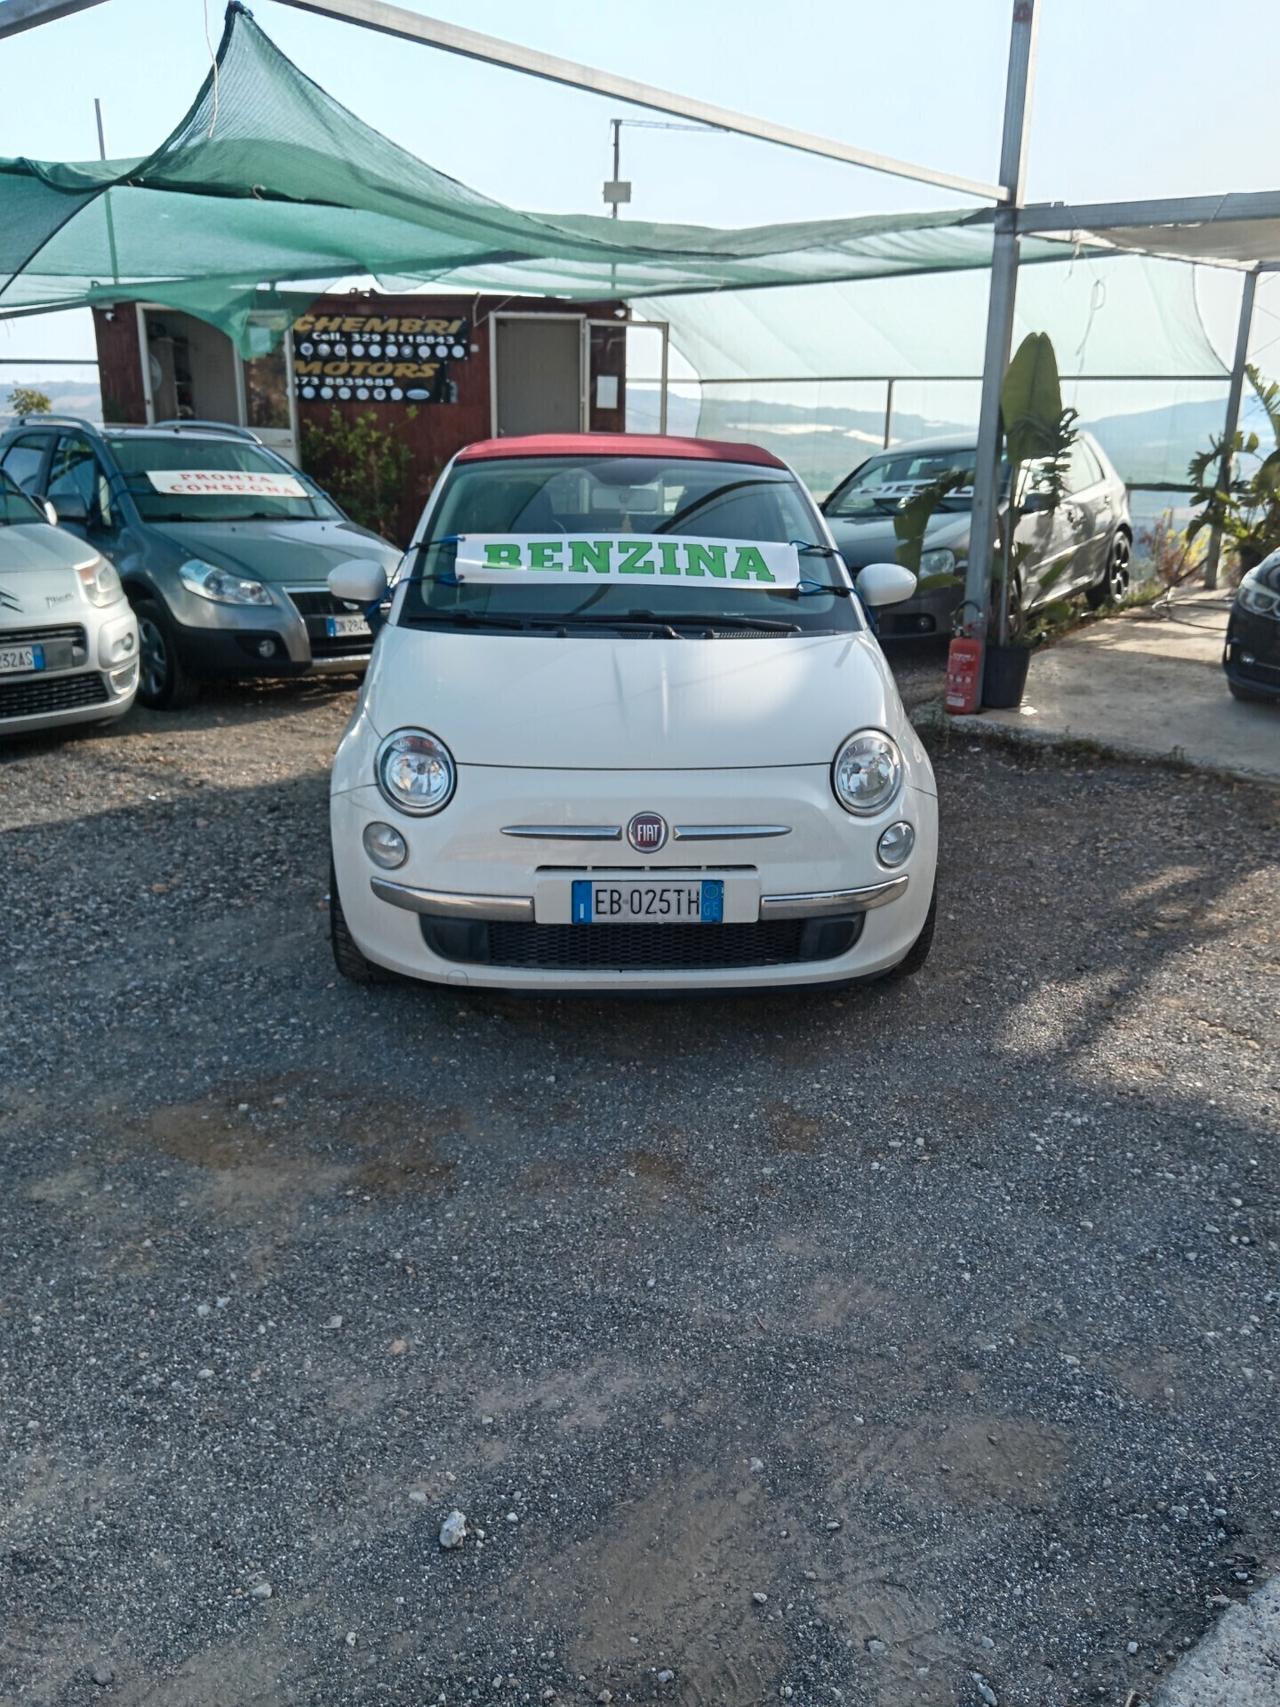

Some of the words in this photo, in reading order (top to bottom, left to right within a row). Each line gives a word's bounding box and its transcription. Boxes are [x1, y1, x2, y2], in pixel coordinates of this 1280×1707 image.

[312, 332, 346, 342] Cell.
[351, 333, 382, 343] 329
[387, 333, 455, 344] 3118843
[294, 361, 440, 379] MOTORS
[179, 473, 272, 483] PRONTA
[170, 484, 296, 496] CONSEGNA
[482, 540, 776, 583] BENZINA
[637, 824, 660, 842] FIAT
